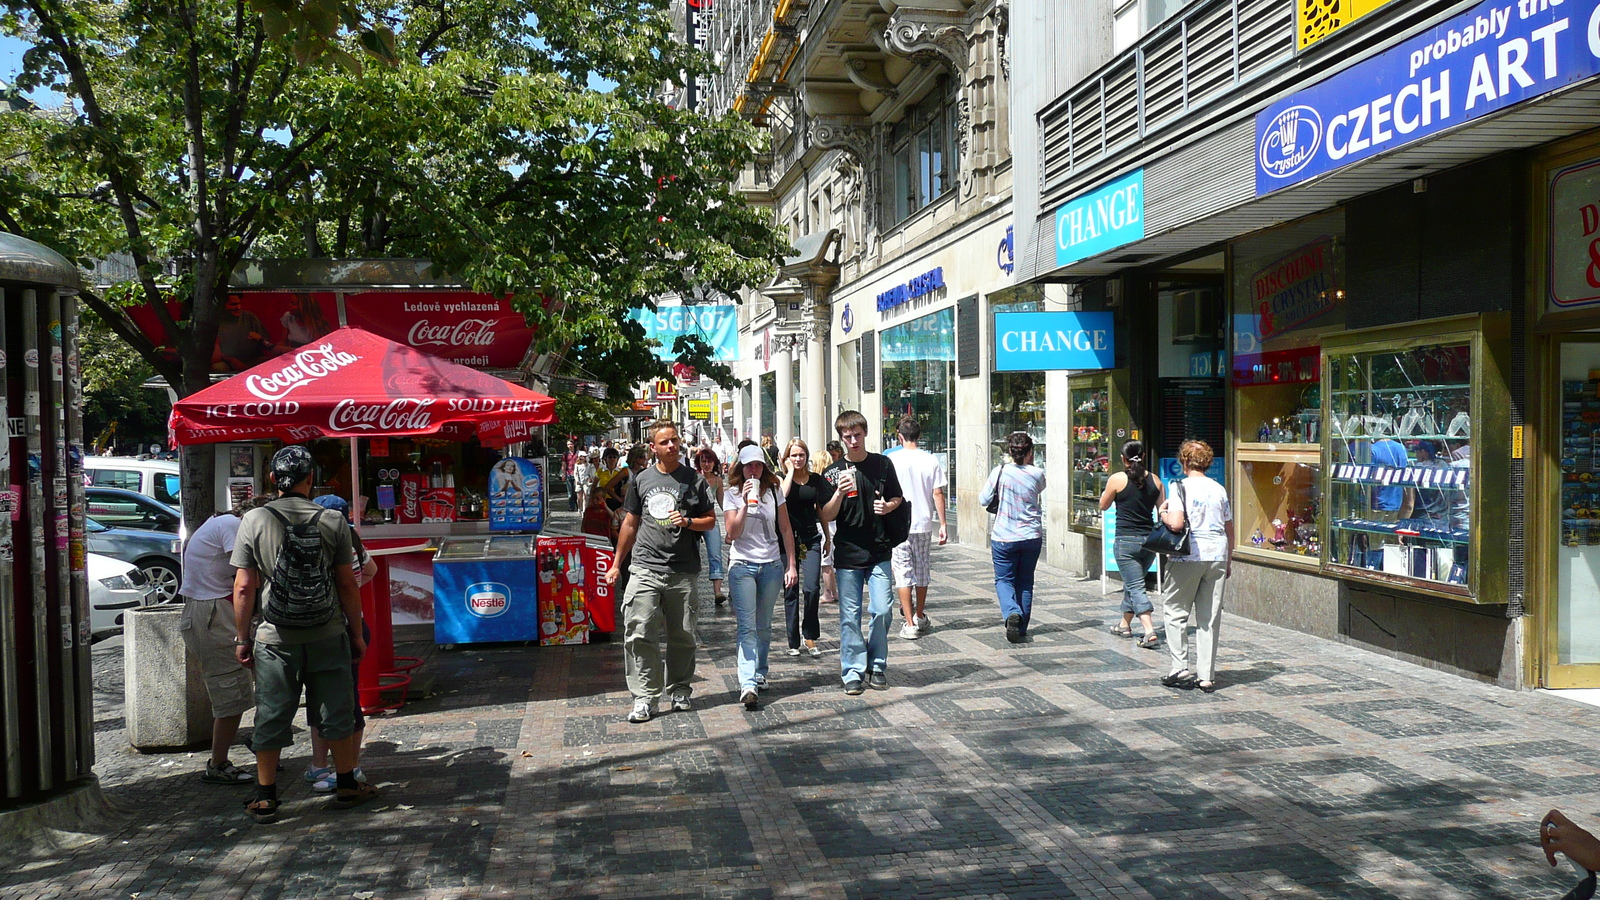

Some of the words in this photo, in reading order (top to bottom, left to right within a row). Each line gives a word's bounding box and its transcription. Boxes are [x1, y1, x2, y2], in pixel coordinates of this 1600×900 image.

[1410, 5, 1511, 78] probably
[1326, 69, 1450, 160] CZECH
[1465, 17, 1569, 110] ART
[1058, 183, 1139, 250] CHANGE
[1255, 245, 1326, 300] DISCOUNT
[404, 301, 441, 312] Ledově
[444, 301, 500, 314] vychlazená
[1258, 301, 1275, 336] &
[1272, 272, 1329, 314] CRYSTAL
[407, 319, 500, 346] Coca-Cola
[1002, 329, 1108, 352] CHANGE
[245, 342, 358, 400] Coca-Cola
[453, 356, 489, 367] prodeji
[1252, 363, 1273, 383] SALE
[206, 403, 238, 418] ICE
[242, 400, 300, 417] COLD
[328, 398, 437, 431] Coca-Cola
[447, 398, 496, 412] SOLD
[499, 399, 541, 413] HERE
[403, 480, 417, 518] Coca-Cola
[591, 550, 612, 597] enjoy
[471, 597, 505, 609] Nestlé
